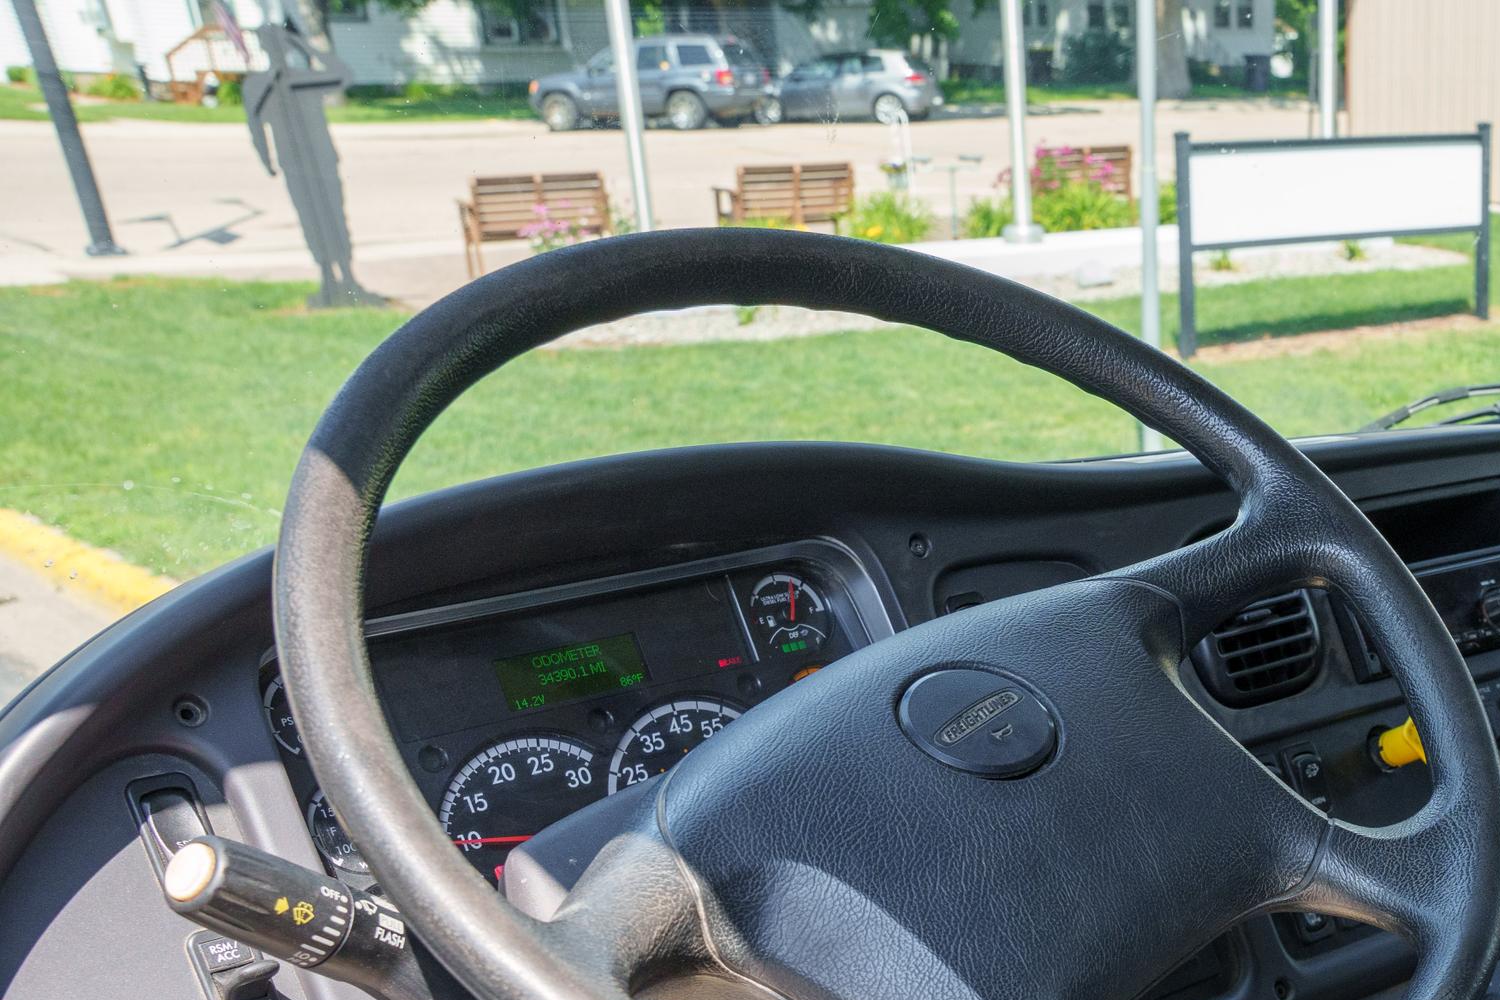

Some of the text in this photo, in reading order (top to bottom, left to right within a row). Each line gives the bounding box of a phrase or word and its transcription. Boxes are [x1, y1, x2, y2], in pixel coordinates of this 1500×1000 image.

[759, 617, 765, 625] E
[532, 644, 601, 668] ODOMETER
[590, 660, 608, 675] MI
[514, 694, 545, 711] 14.2V
[669, 714, 693, 734] 45
[700, 717, 724, 738] 55
[943, 691, 1017, 742] FREIGHTLINER
[640, 732, 665, 753] 35
[488, 763, 516, 785] 20
[527, 753, 554, 775] 25
[622, 763, 649, 786] 25
[565, 766, 592, 788] 30
[463, 792, 488, 814] 15
[457, 830, 483, 852] 10
[320, 885, 341, 901] OFF
[374, 926, 406, 949] FLASH
[217, 949, 241, 962] ACC
